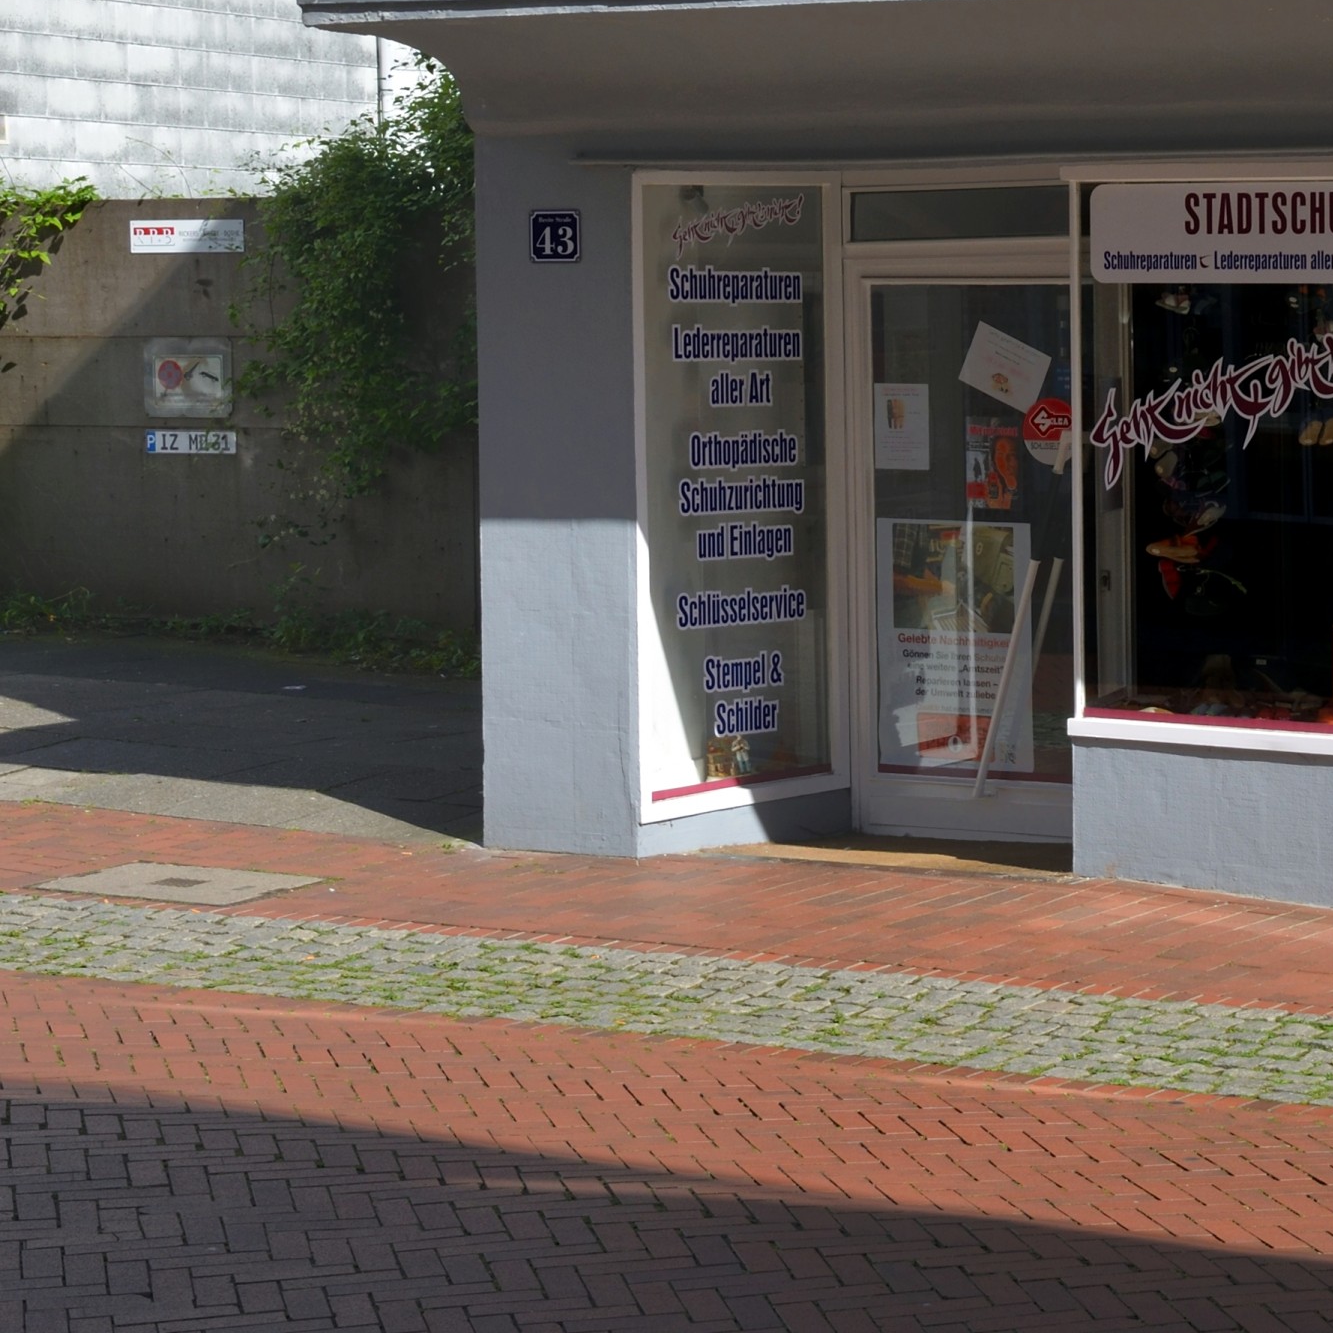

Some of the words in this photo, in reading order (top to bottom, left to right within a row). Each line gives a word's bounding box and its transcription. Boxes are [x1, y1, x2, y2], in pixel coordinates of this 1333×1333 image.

[536, 226, 575, 255] 43
[1104, 250, 1197, 271] Schuhreparaturen
[1214, 250, 1307, 271] Lederreparaturen
[669, 267, 801, 304] Schuhreparaturen
[674, 326, 801, 362] Lederreparaturen
[711, 372, 745, 405] aller
[749, 371, 771, 404] Art
[161, 434, 179, 450] IZ
[691, 431, 797, 469] Orthopädische
[680, 478, 803, 514] Schuhzurichtung
[698, 525, 725, 558] und
[729, 523, 792, 558] Einlagen
[678, 587, 805, 628] Schlüsselservice
[898, 633, 937, 644] Gelebte
[940, 635, 1010, 650] Nachhltigkei
[902, 649, 935, 659] Gönnen
[705, 653, 765, 690] Stempel
[770, 653, 782, 684] &
[963, 678, 991, 688] lasen
[966, 690, 996, 700] zliebe
[716, 699, 777, 735] Schilder
